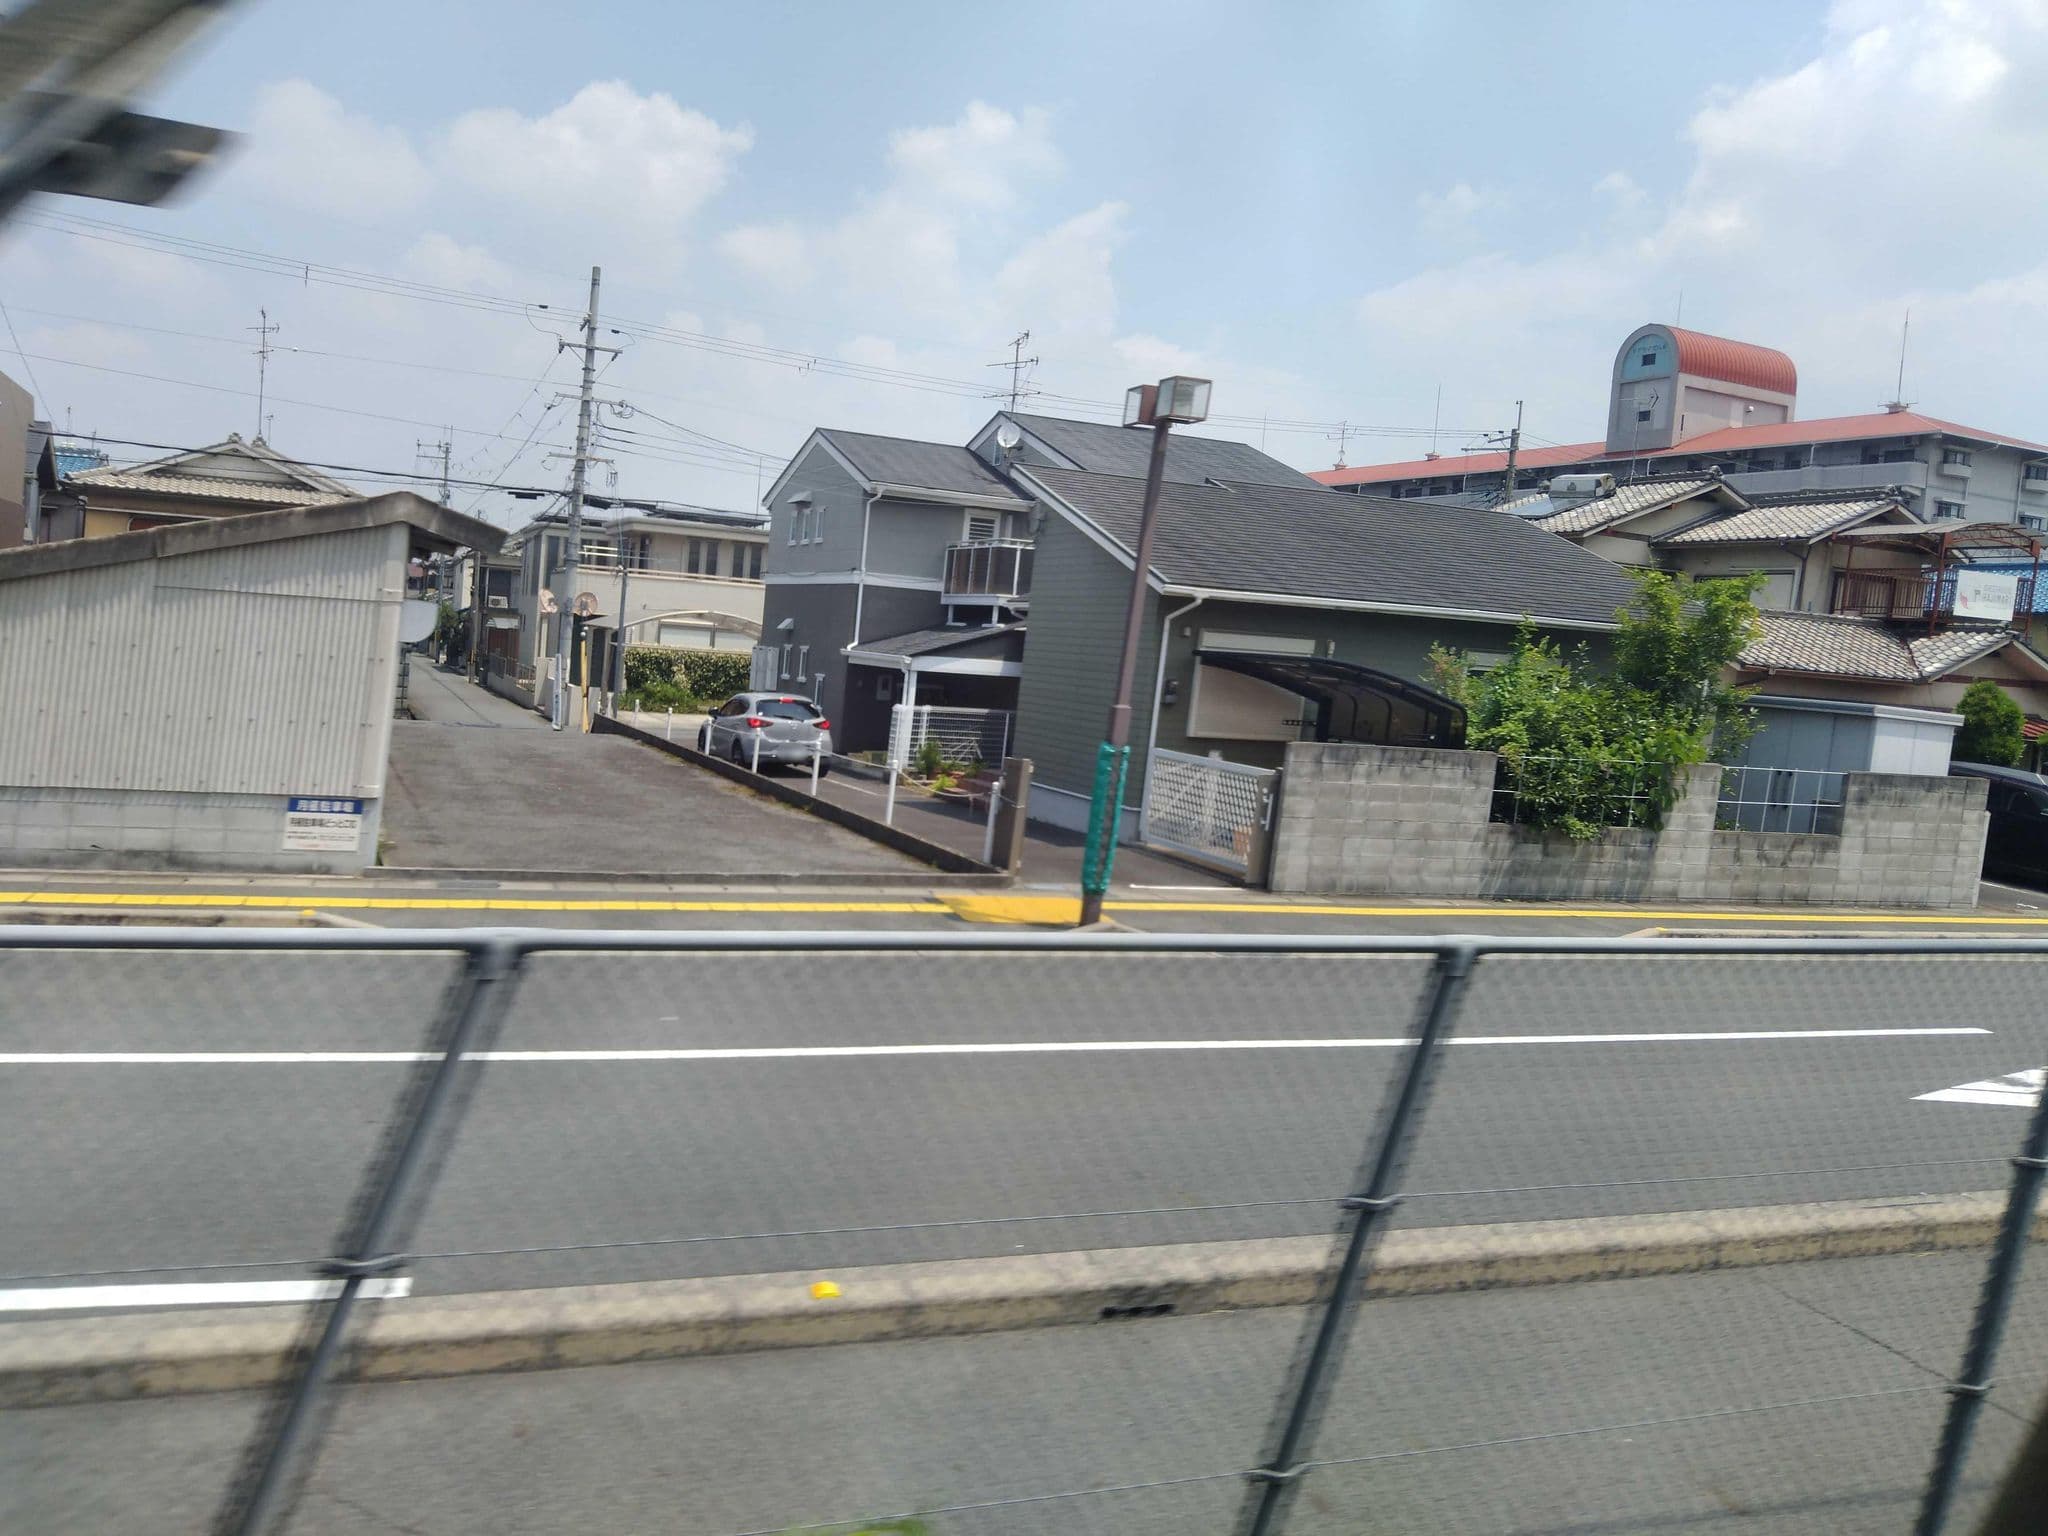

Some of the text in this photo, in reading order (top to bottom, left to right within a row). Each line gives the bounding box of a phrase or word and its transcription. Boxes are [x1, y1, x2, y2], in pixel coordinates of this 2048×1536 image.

[296, 800, 355, 812] 月極駐車場
